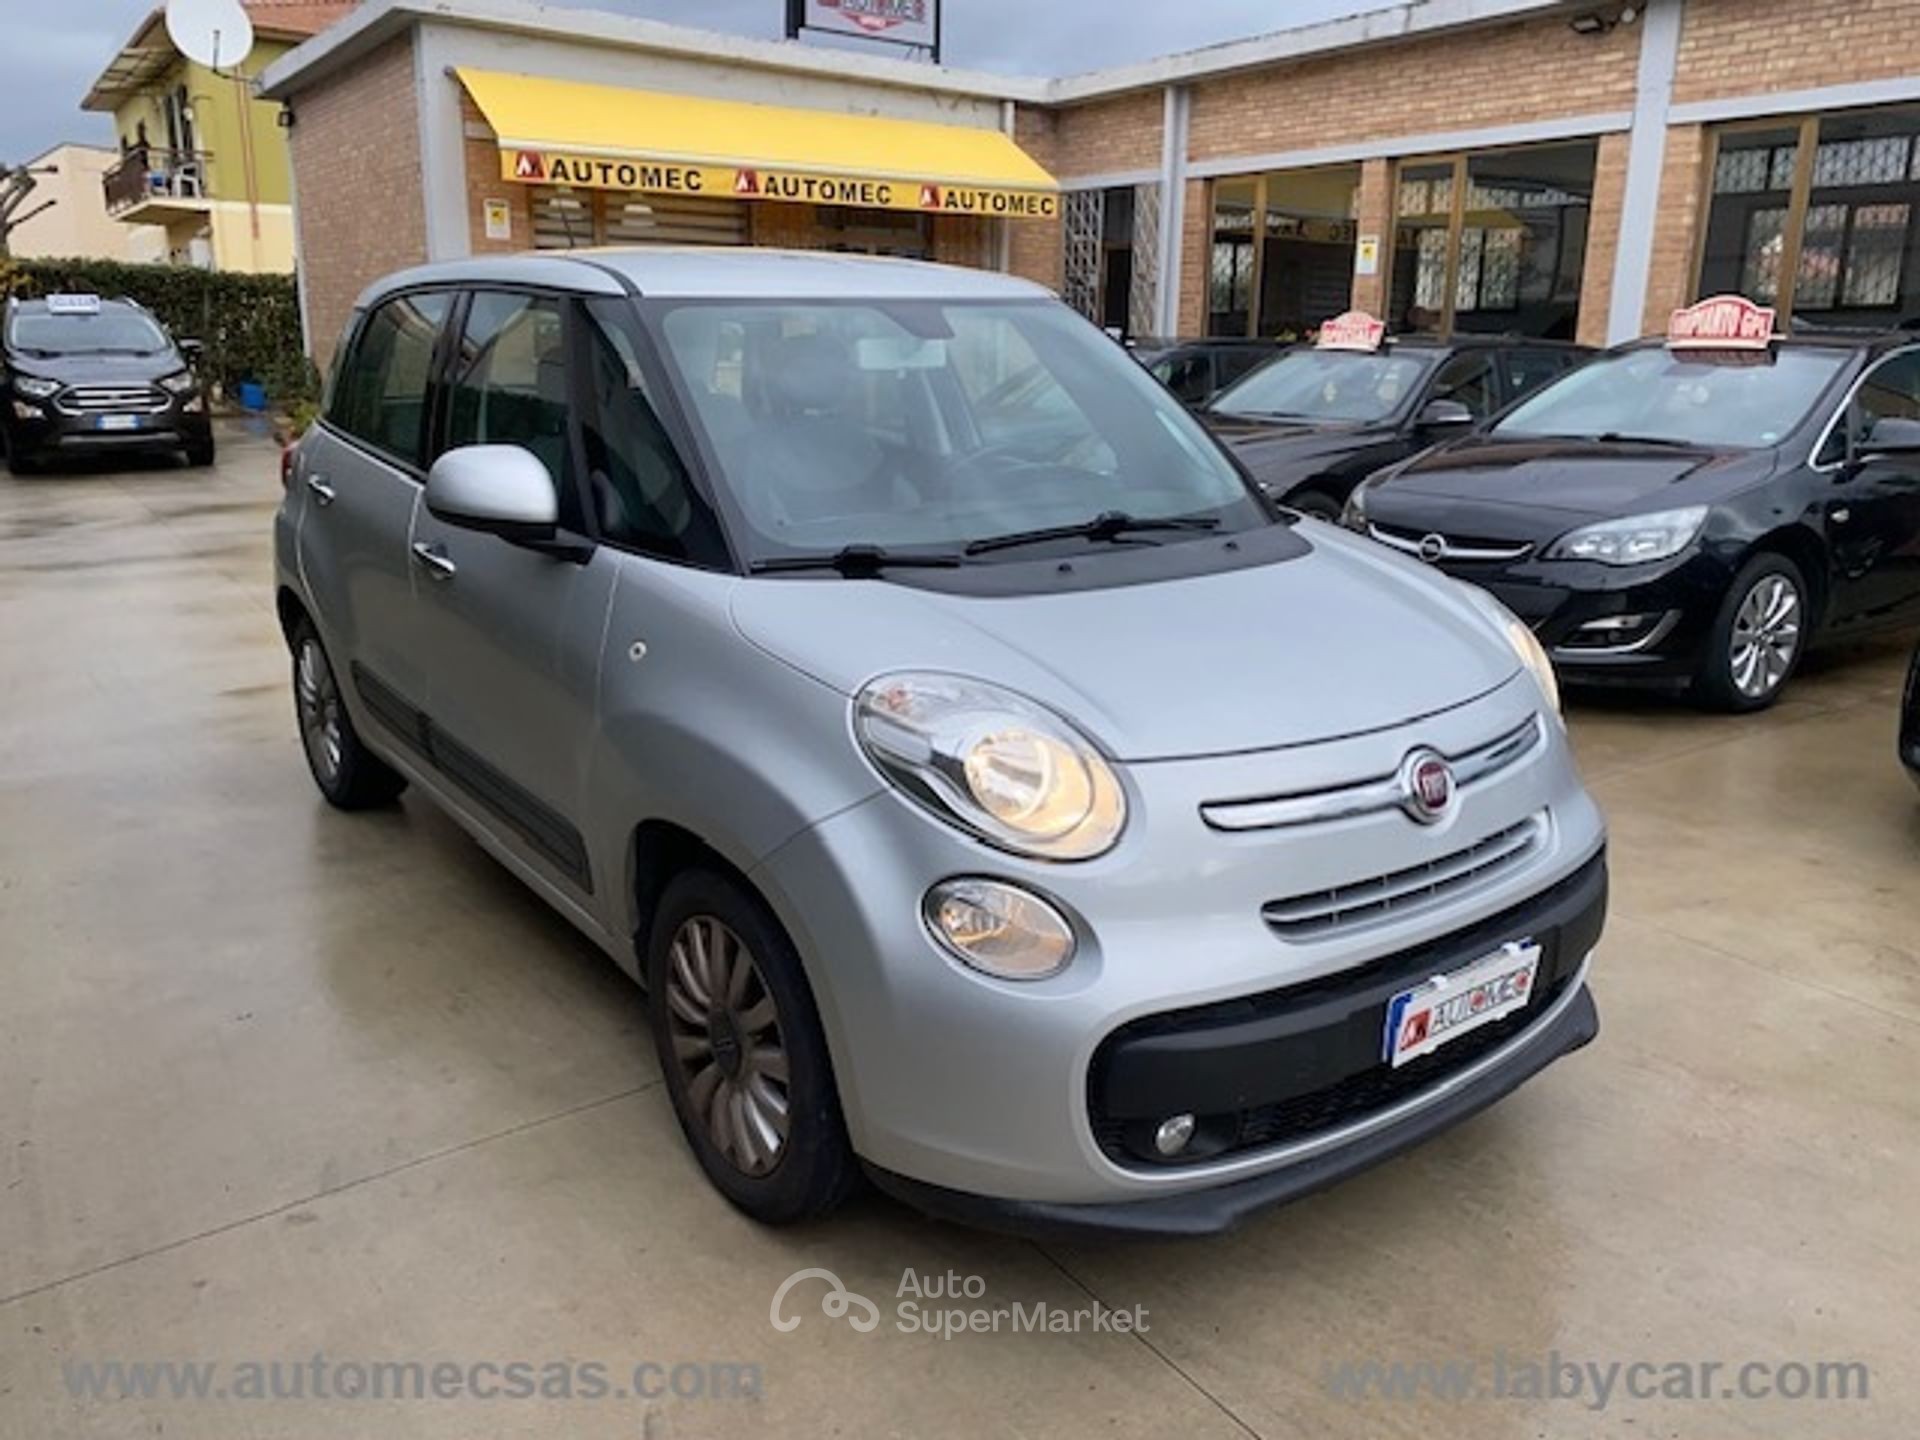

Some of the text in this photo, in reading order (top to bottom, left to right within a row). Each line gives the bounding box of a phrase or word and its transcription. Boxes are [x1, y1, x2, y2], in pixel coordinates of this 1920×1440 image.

[550, 158, 703, 191] AUTOMEC
[764, 175, 892, 205] AUTOMEC
[944, 189, 1055, 215] AUTOMEC
